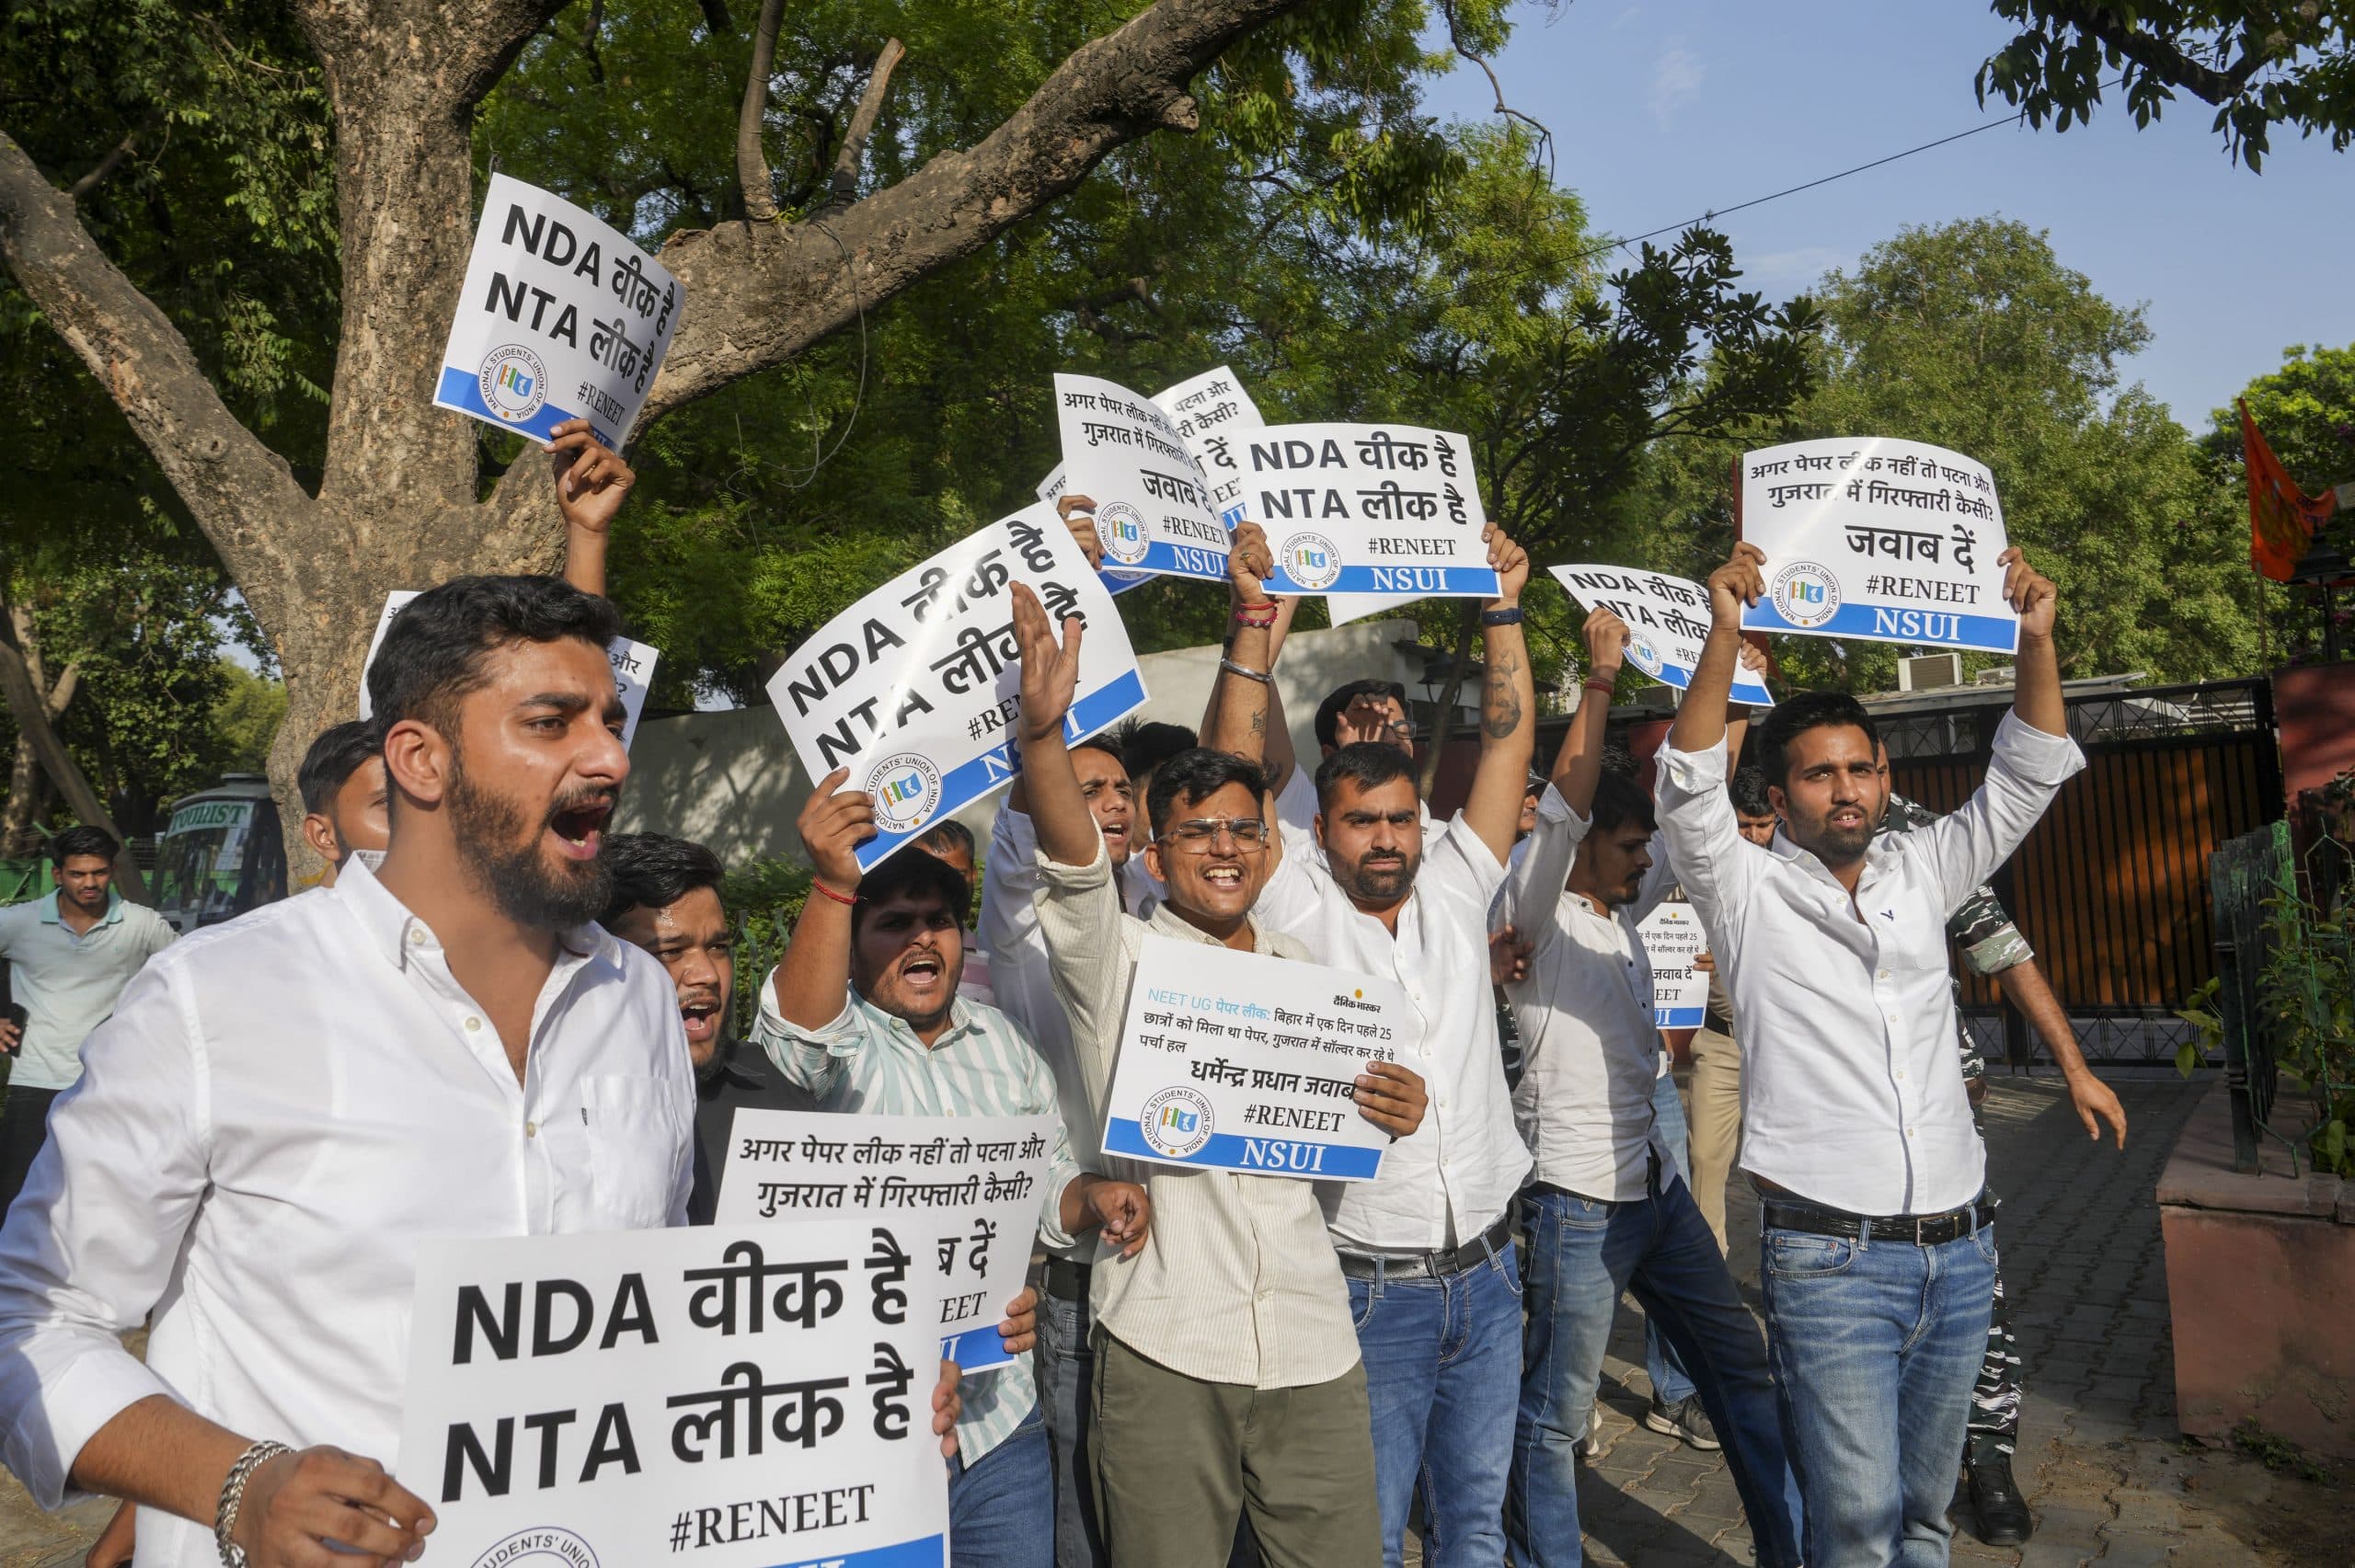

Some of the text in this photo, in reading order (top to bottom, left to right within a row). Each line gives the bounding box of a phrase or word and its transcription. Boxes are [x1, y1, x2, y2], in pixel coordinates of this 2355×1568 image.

[501, 204, 601, 288] NDA
[612, 255, 661, 318] वीक
[485, 271, 577, 349] NTA
[590, 318, 641, 379] लीक
[482, 366, 498, 409] NATIONAL
[534, 361, 545, 389] UNION
[517, 405, 536, 418] INDIA
[577, 381, 625, 426] #RENEET
[1064, 393, 1096, 409] अगर
[1098, 393, 1123, 415] पेपर
[1125, 402, 1147, 423] लीक
[1174, 381, 1233, 412] पटना और
[1194, 402, 1238, 429] कैसी?
[1082, 422, 1132, 447] गुजरात
[1133, 426, 1144, 449] में
[1203, 436, 1237, 469] दें
[1250, 439, 1349, 472] NDA
[1354, 431, 1428, 471] वीक
[1434, 434, 1456, 477] है
[1140, 468, 1198, 508] जवाब
[1751, 461, 1790, 478] अगर
[1794, 454, 1832, 471] पेपर
[1887, 455, 1918, 476] नहीं
[1921, 459, 1937, 478] तो
[1941, 465, 1970, 486] पटना
[1974, 473, 1991, 496] और
[1260, 489, 1350, 519] NTA
[1357, 480, 1438, 521] लीक
[1443, 483, 1466, 525] है
[1846, 479, 1862, 501] में
[1867, 480, 1951, 511] गिरफ्तारी
[1955, 490, 1993, 521] कैसी?
[1163, 515, 1226, 544] #RENEET
[1368, 538, 1456, 555] #RENEET
[1171, 545, 1225, 575] NSUI
[1283, 555, 1306, 584] NATIONAL
[1319, 539, 1337, 557] UNION
[1844, 523, 1976, 574] जवाब दें
[1371, 567, 1450, 590] NSUI
[1569, 573, 1643, 594] NDA
[1642, 576, 1695, 607] वीक
[1821, 571, 1836, 592] UNION
[1867, 575, 1980, 604] #RENEET
[1775, 587, 1796, 621] NATIONAL
[1815, 607, 1833, 623] INDIA
[1832, 596, 1837, 606] OF
[787, 618, 907, 717] NDA
[1006, 521, 1055, 573] है
[1873, 607, 1961, 641] NSUI
[815, 684, 936, 771] NTA
[905, 758, 931, 773] UNION
[929, 773, 937, 785] OF
[924, 788, 937, 813] INDIA
[172, 806, 247, 831] TOURIST
[1148, 987, 1391, 1040] NEET UG पेपर लीक: बिहार में एक दिन पहले 25
[1140, 1035, 1187, 1053] पर्चा हल
[1143, 1013, 1395, 1062] छात्रों को मिला था पेपर, गुजरात में सॉल्वर कर रहे थे
[1190, 1057, 1356, 1100] धर्मेन्द्र प्रधान जवाब
[1196, 1098, 1211, 1121] UNION
[1244, 1104, 1345, 1132] #RENEET
[1144, 1111, 1163, 1150] NATIONAL
[1183, 1137, 1204, 1152] INDIA
[1203, 1126, 1210, 1136] OF
[740, 1132, 1046, 1166] अगर पेपर लीक नहीं तो पटना और
[1240, 1139, 1327, 1172] NSUI
[757, 1170, 1034, 1219] गुजरात में गिरफ्तारी कैसी?
[969, 1218, 996, 1280] दें
[453, 1273, 661, 1366] NDA
[683, 1240, 848, 1337] वीक
[864, 1227, 912, 1324] है
[441, 1341, 914, 1503] NTA लीक है
[668, 1484, 875, 1552] #RENEET
